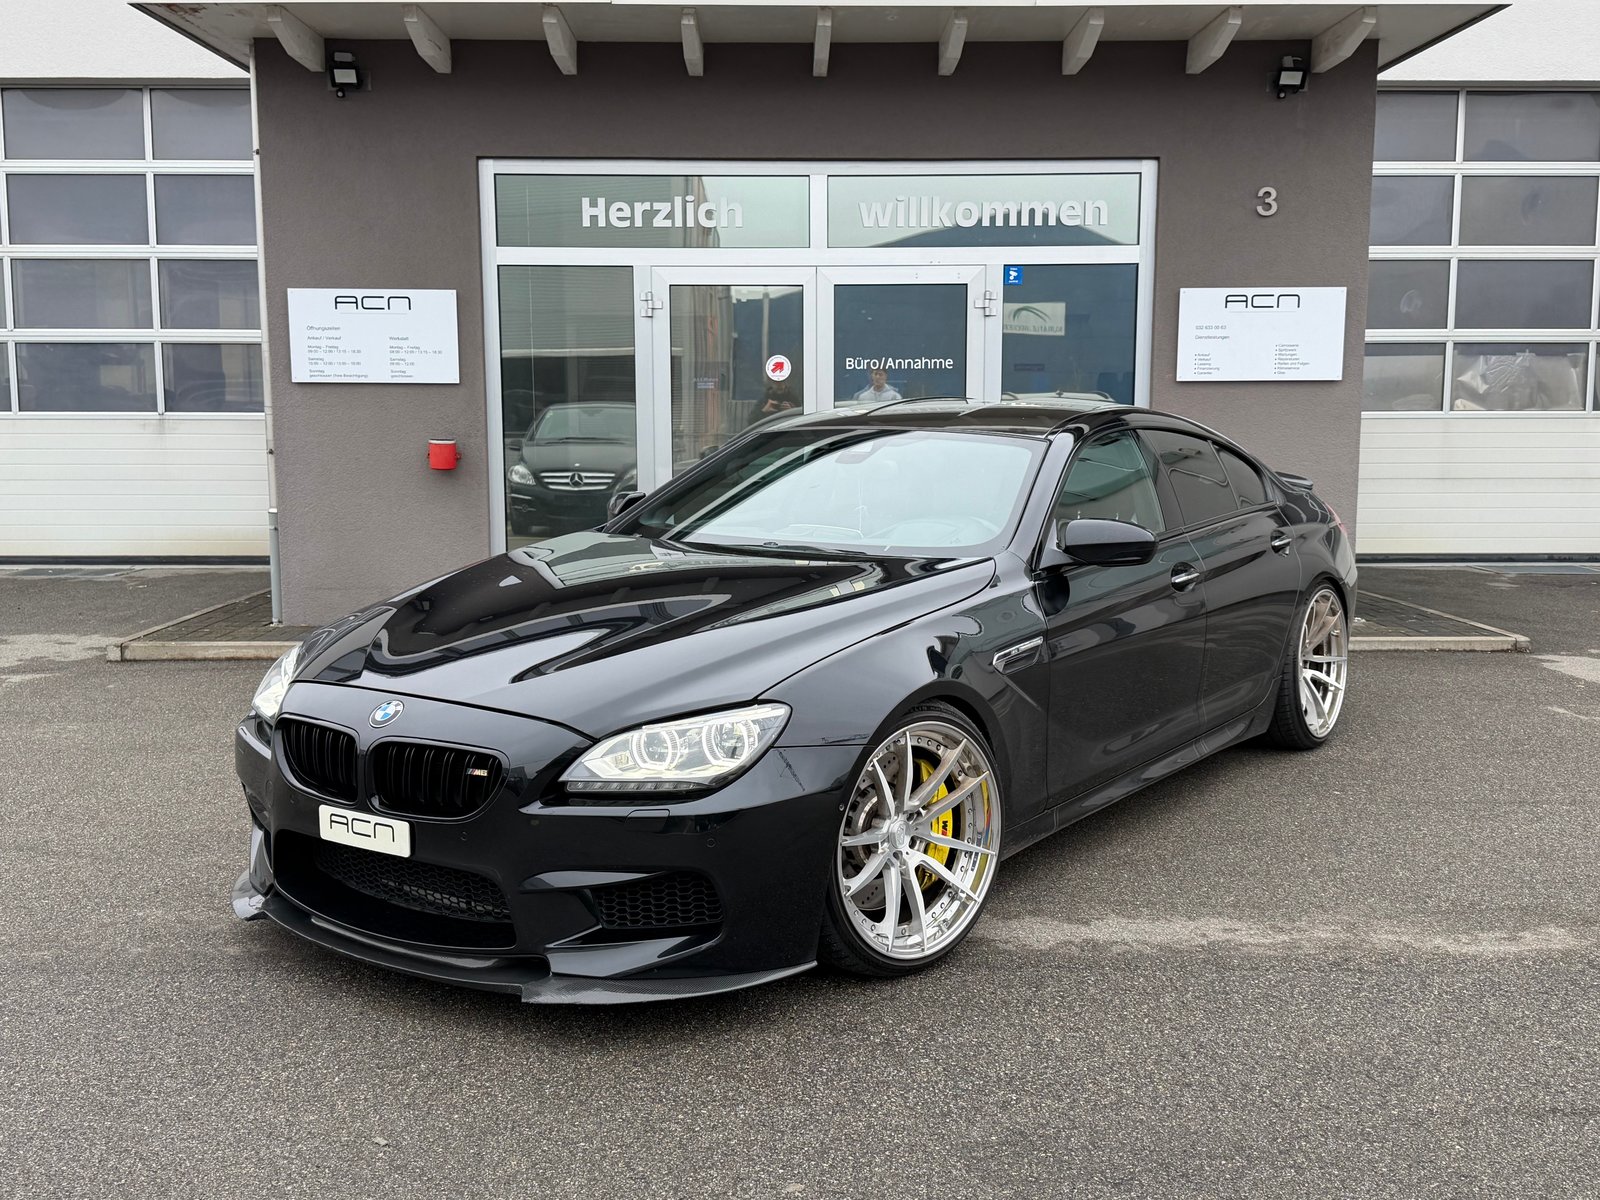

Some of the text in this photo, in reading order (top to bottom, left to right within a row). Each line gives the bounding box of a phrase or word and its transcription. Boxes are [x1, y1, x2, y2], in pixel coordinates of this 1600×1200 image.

[580, 193, 1109, 228] Herzlich willkommen
[1256, 186, 1278, 216] 3
[845, 356, 954, 370] Büro/Annahme
